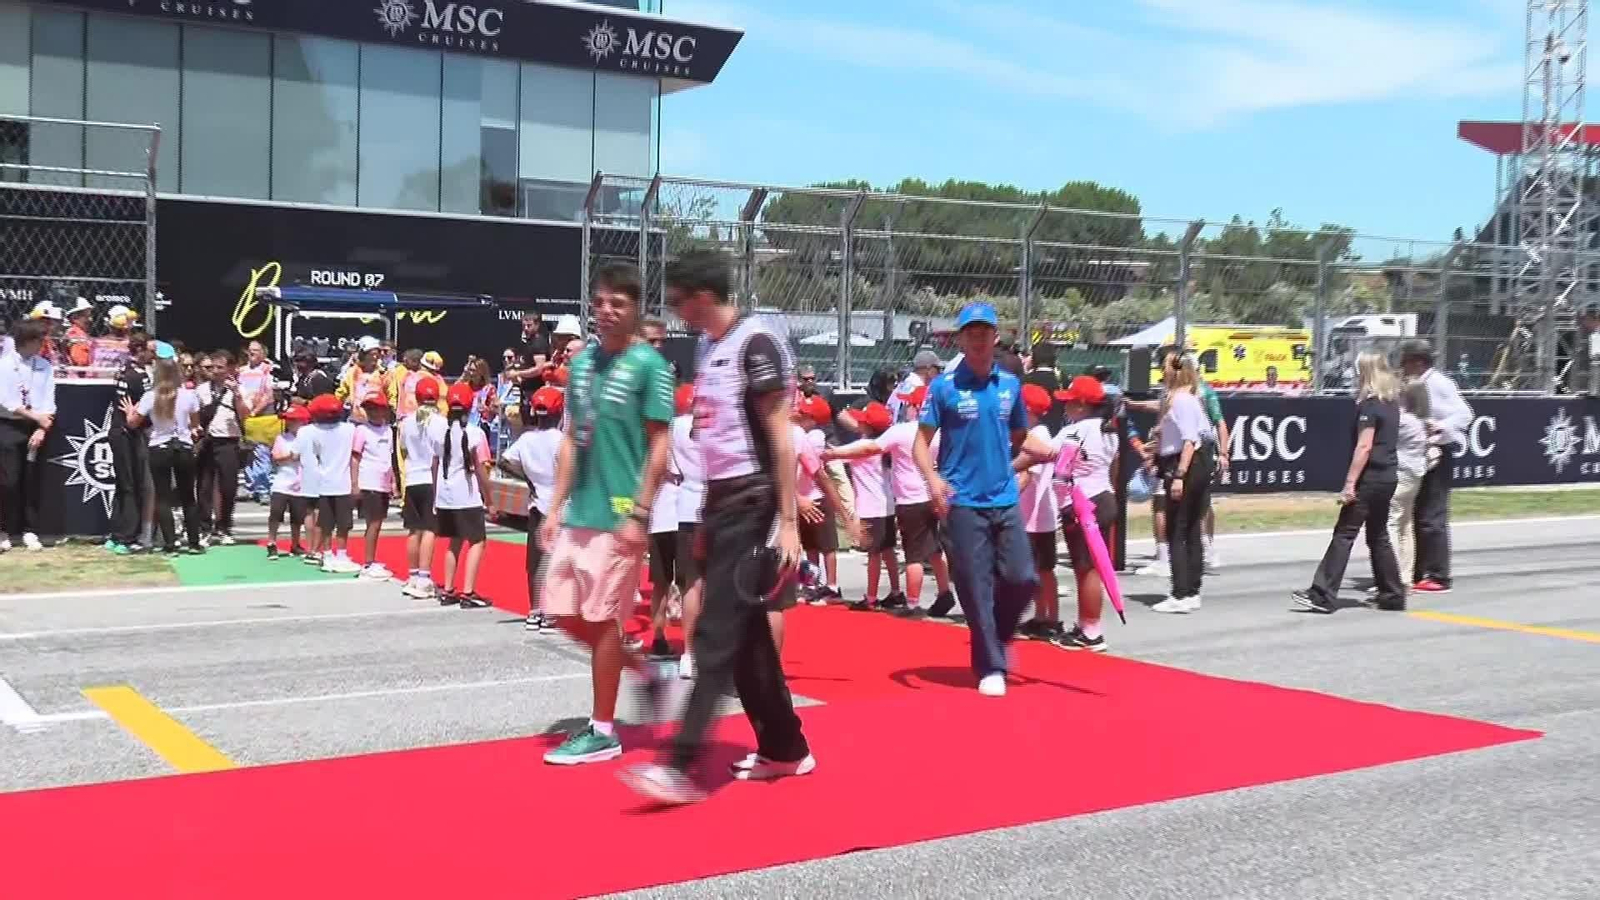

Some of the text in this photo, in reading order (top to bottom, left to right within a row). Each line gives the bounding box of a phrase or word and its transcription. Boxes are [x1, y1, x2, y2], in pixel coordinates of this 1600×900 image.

[421, 0, 503, 36] MSC
[418, 33, 499, 52] CRUISES
[623, 27, 696, 62] MSC
[620, 59, 690, 75] CRUISES
[311, 271, 385, 287] ROUND 07
